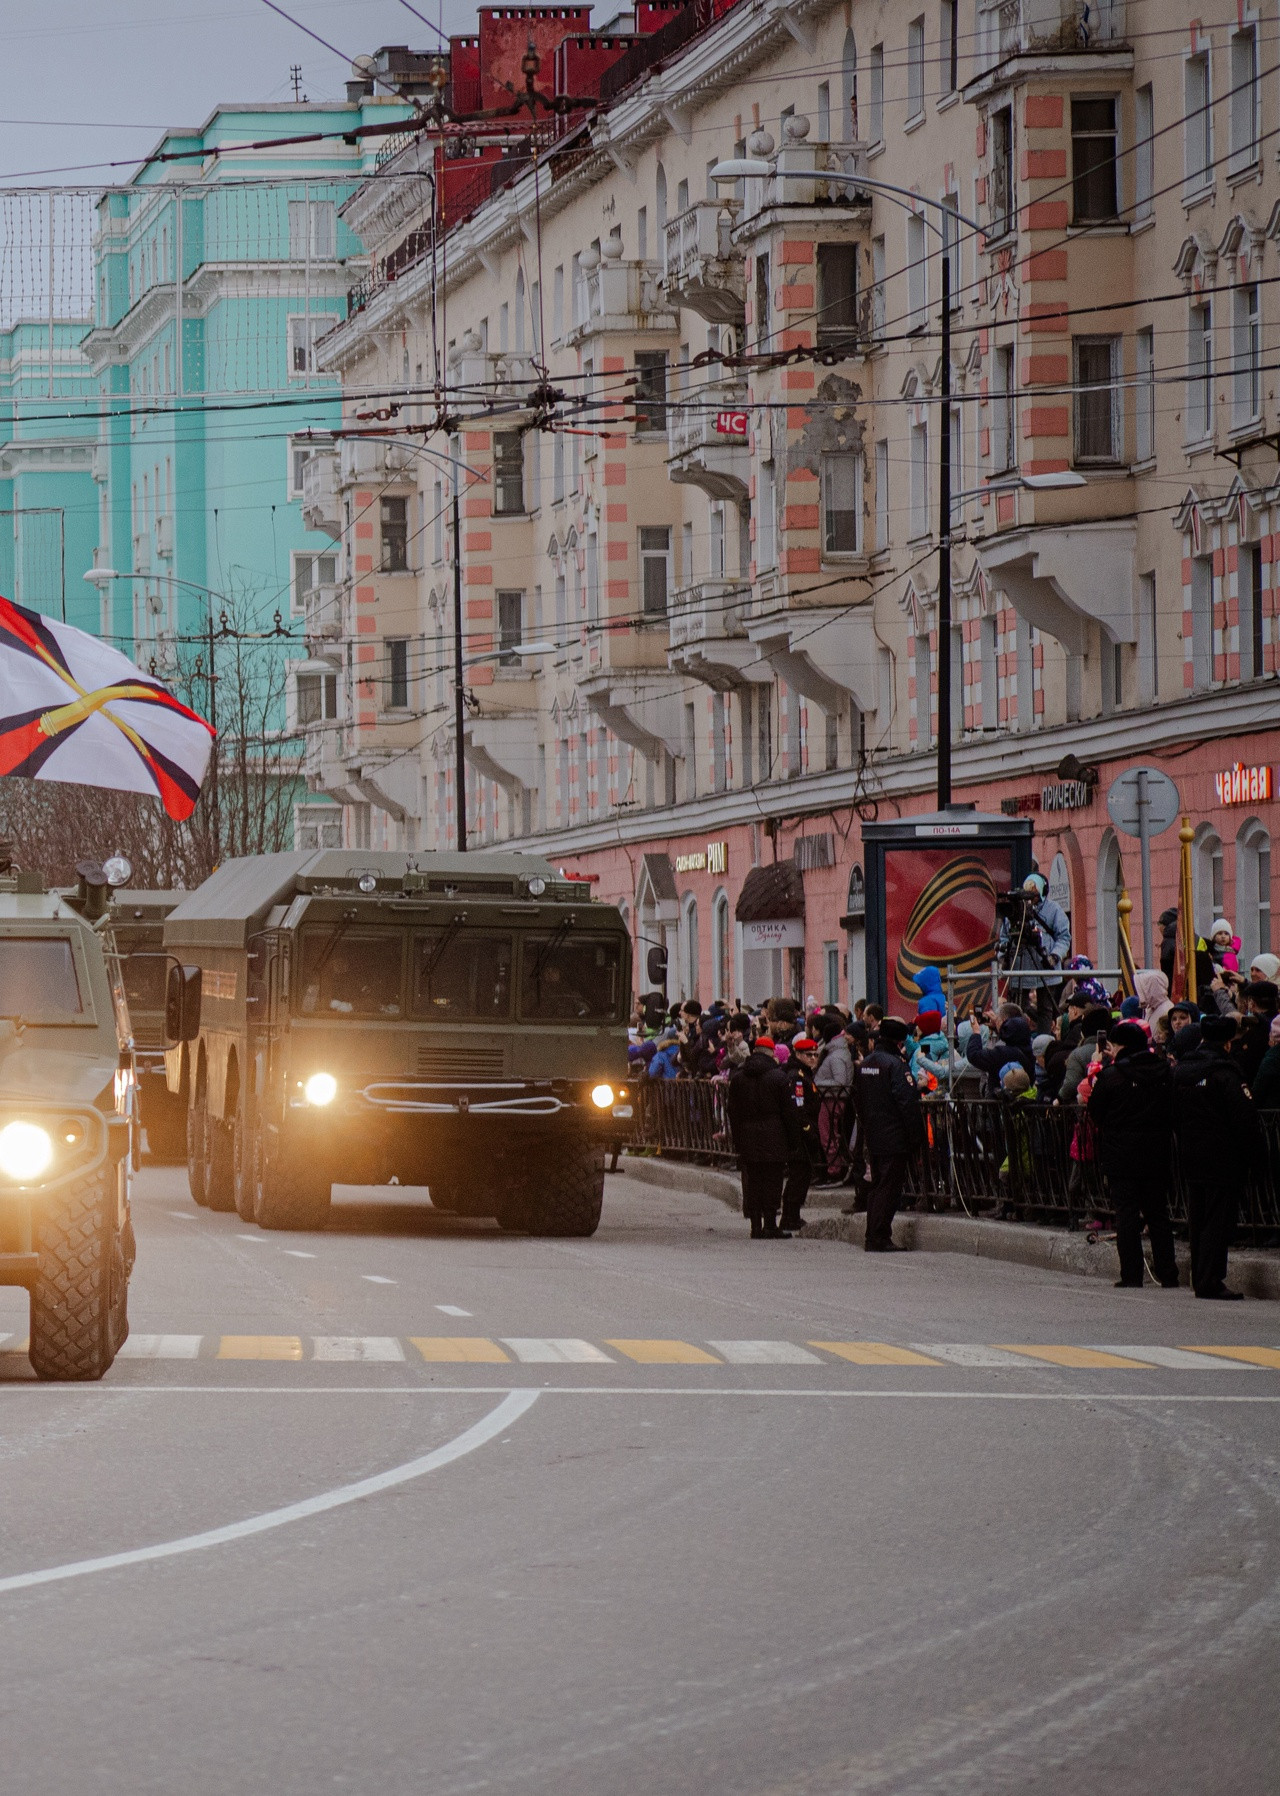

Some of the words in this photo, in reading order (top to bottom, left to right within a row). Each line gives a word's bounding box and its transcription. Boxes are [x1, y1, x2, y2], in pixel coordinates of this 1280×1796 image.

[720, 413, 745, 432] ЧС
[1041, 781, 1087, 811] ПРИЧЕСКИ
[751, 924, 788, 933] ОПТИКА
